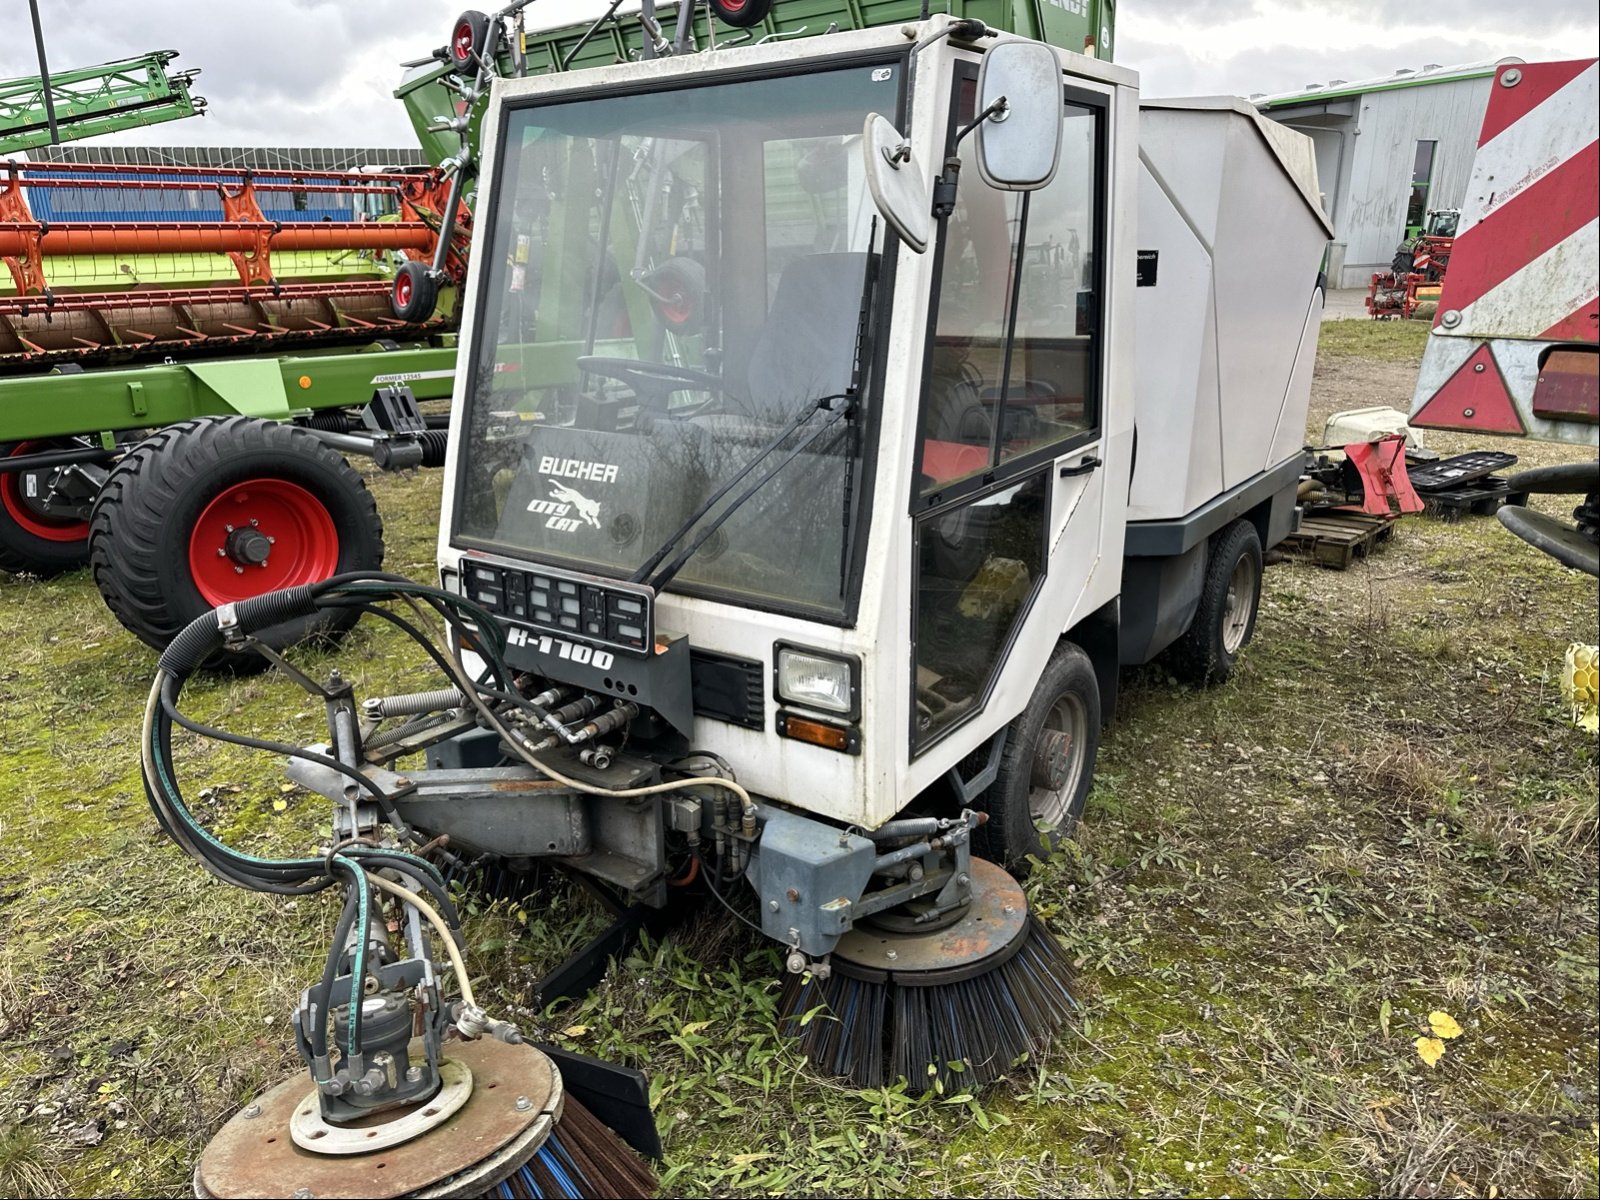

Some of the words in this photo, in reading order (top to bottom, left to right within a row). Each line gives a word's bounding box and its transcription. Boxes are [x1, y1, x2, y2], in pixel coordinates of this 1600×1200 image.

[376, 375, 402, 383] FORMER
[403, 373, 422, 381] 12545
[538, 456, 619, 483] BUCHER
[526, 499, 571, 517] CITY
[545, 516, 583, 532] CAT
[507, 626, 614, 671] K-1700
